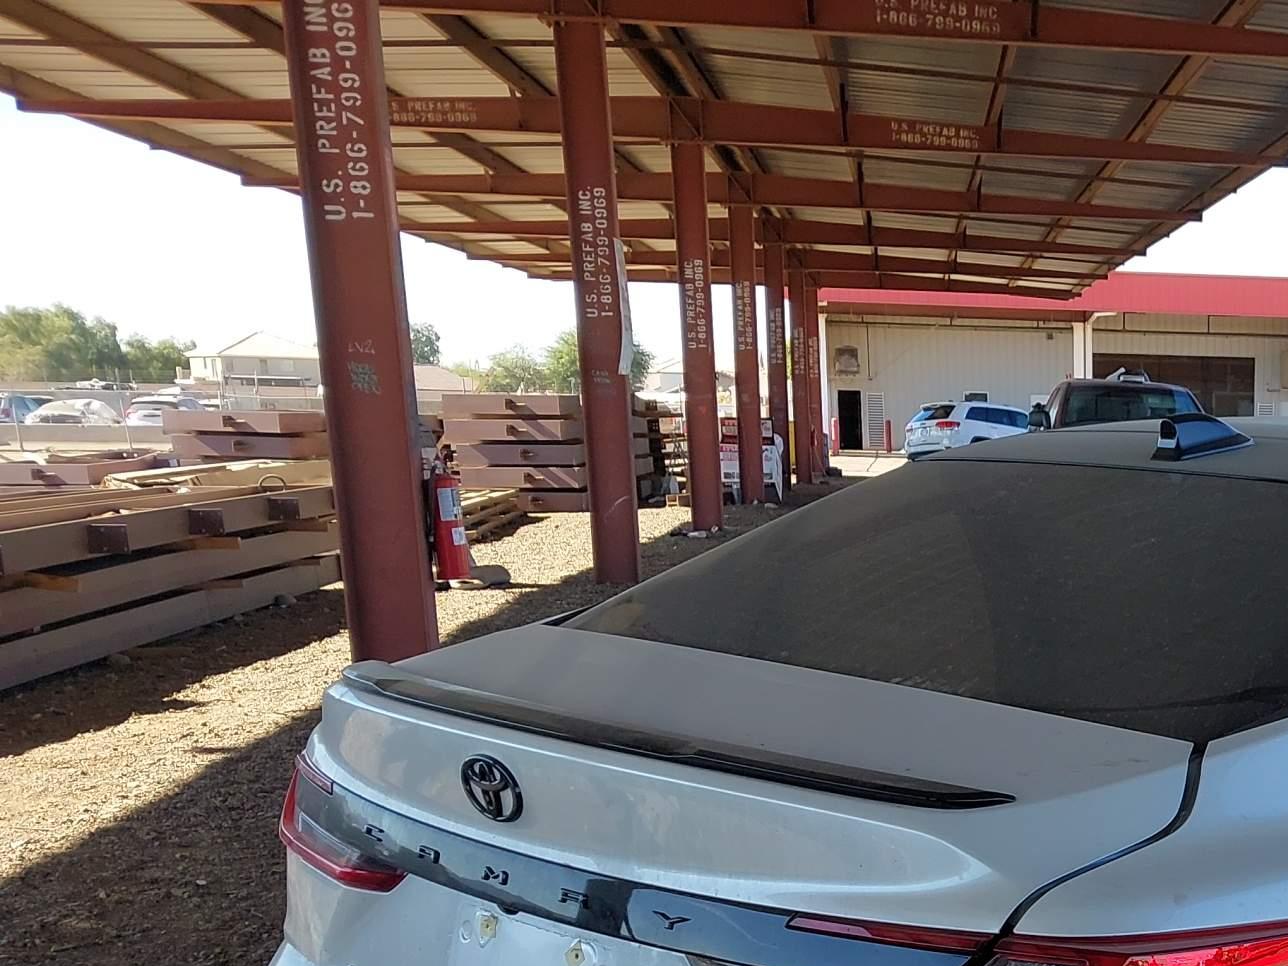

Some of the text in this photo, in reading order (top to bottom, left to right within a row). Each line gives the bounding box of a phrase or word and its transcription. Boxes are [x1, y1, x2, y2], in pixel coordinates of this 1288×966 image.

[308, 47, 340, 153] PREFAB
[322, 170, 347, 220] U.S.
[578, 185, 599, 318] U.S. PREFAB INC.
[593, 187, 614, 317] 1-866-799-0969
[685, 283, 697, 324] PREFAB
[363, 823, 693, 931] CAMRY
